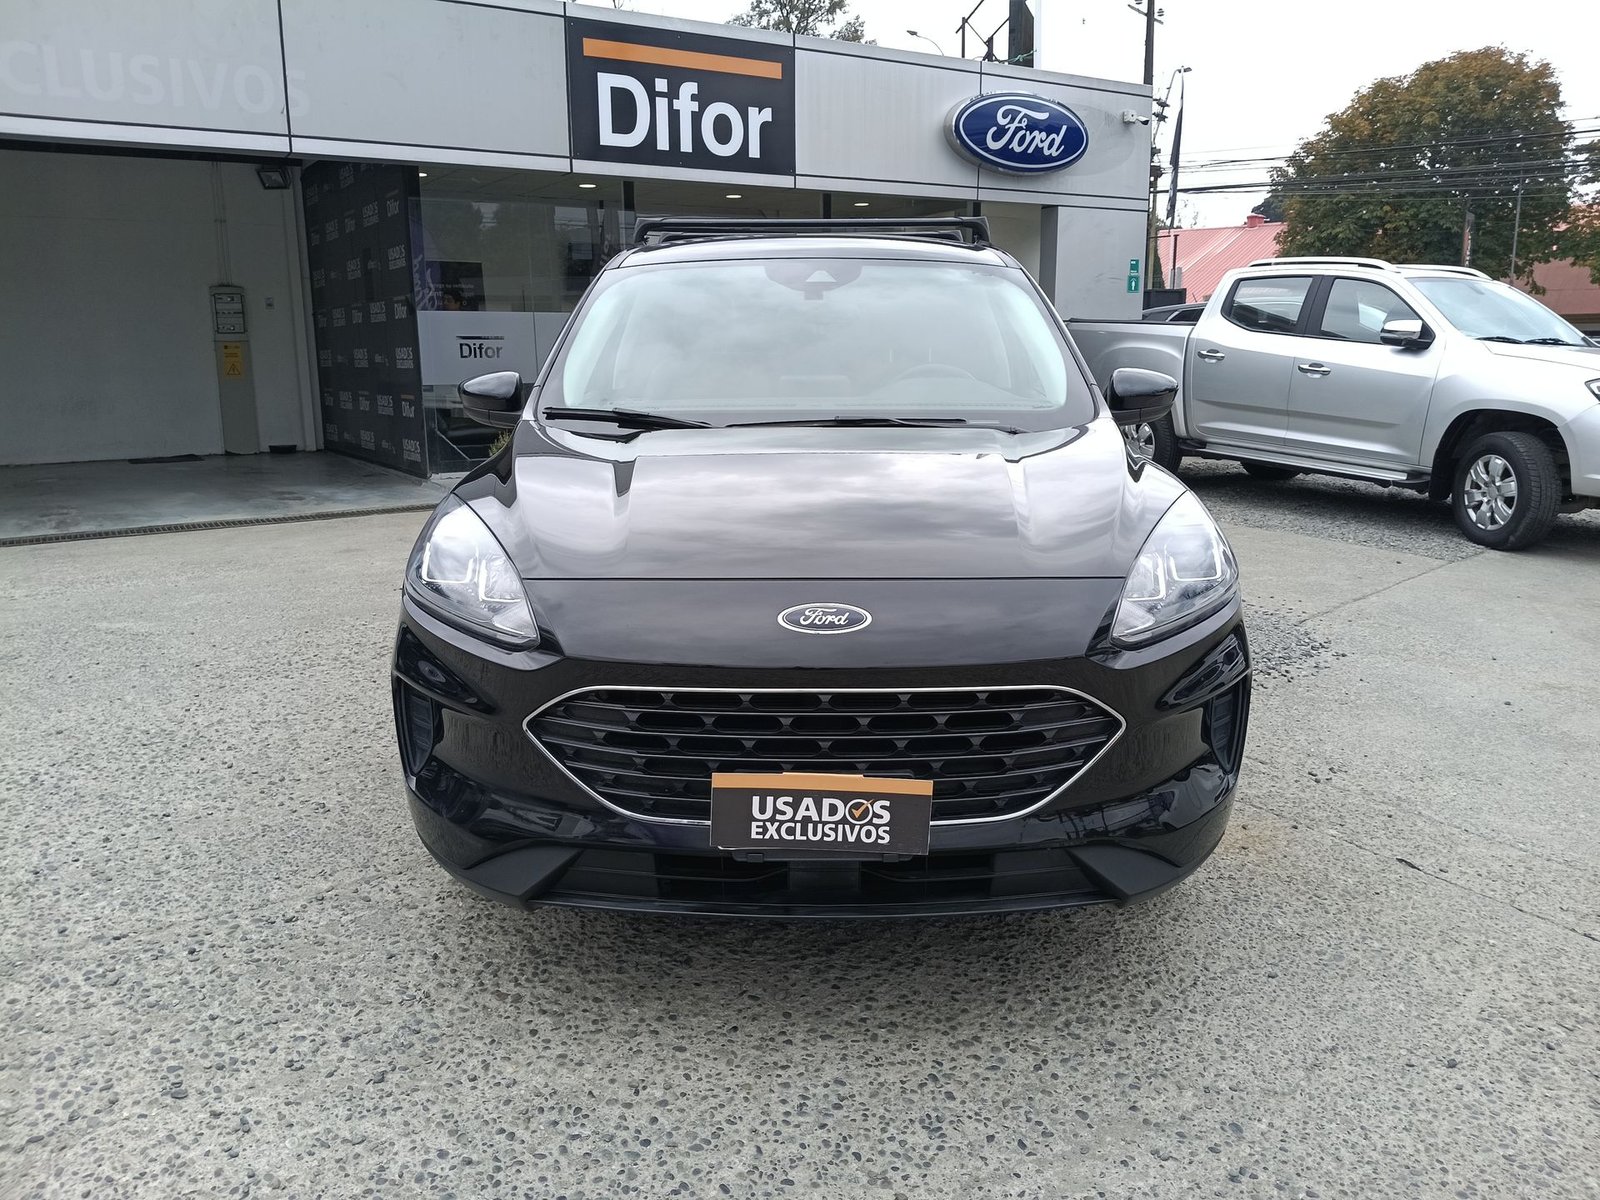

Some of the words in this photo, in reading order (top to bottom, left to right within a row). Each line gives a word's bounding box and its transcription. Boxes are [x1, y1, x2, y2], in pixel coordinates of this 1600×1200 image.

[596, 72, 773, 159] Difor
[986, 104, 1068, 157] Ford
[459, 342, 503, 359] Difor
[799, 606, 849, 627] Ford
[751, 795, 890, 825] USADOS
[750, 821, 890, 844] EXCLUSIVOS
